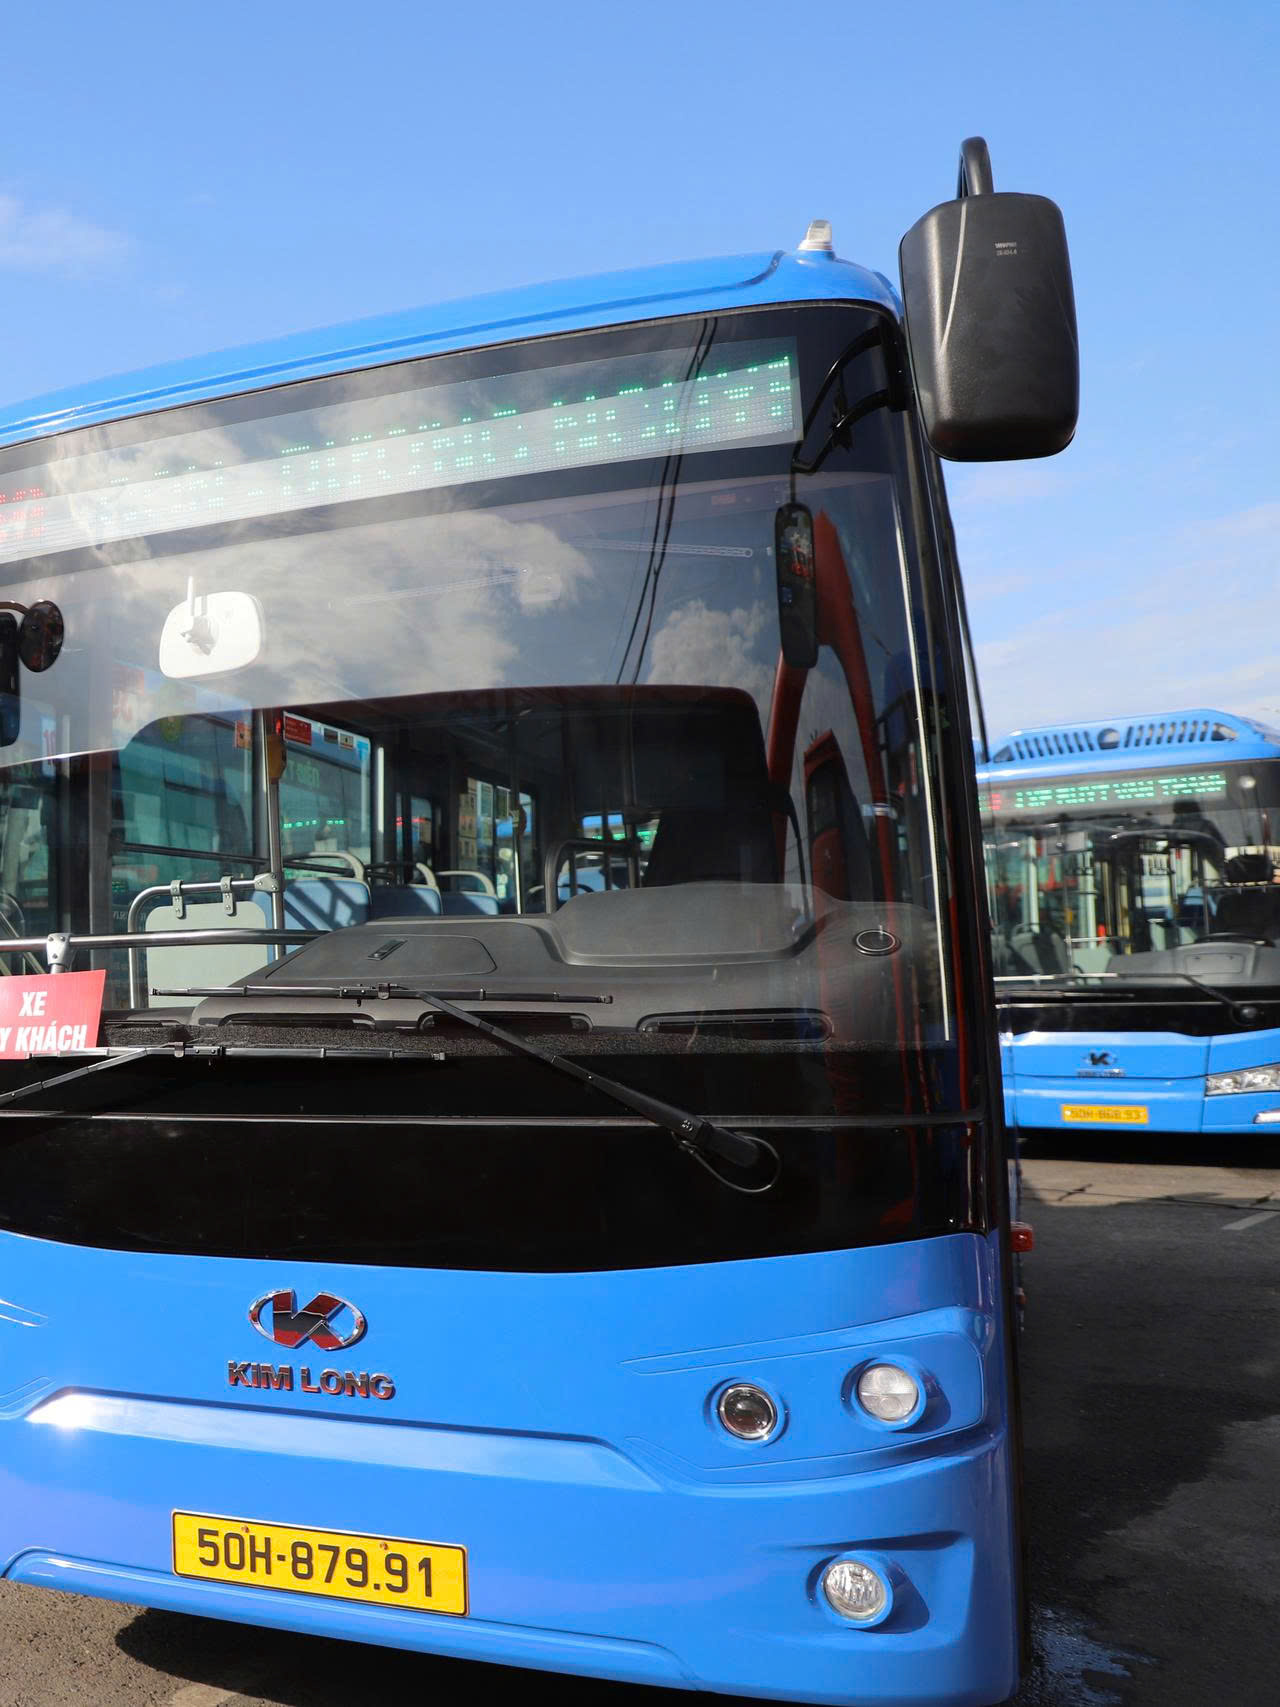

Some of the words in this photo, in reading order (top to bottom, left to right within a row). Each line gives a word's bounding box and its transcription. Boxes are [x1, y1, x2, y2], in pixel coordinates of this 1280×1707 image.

[18, 992, 48, 1016] XE
[15, 1020, 88, 1051] KHÁCH
[227, 1360, 294, 1391] KIM
[300, 1366, 396, 1400] LONG
[198, 1528, 433, 1598] 50H-879.91
